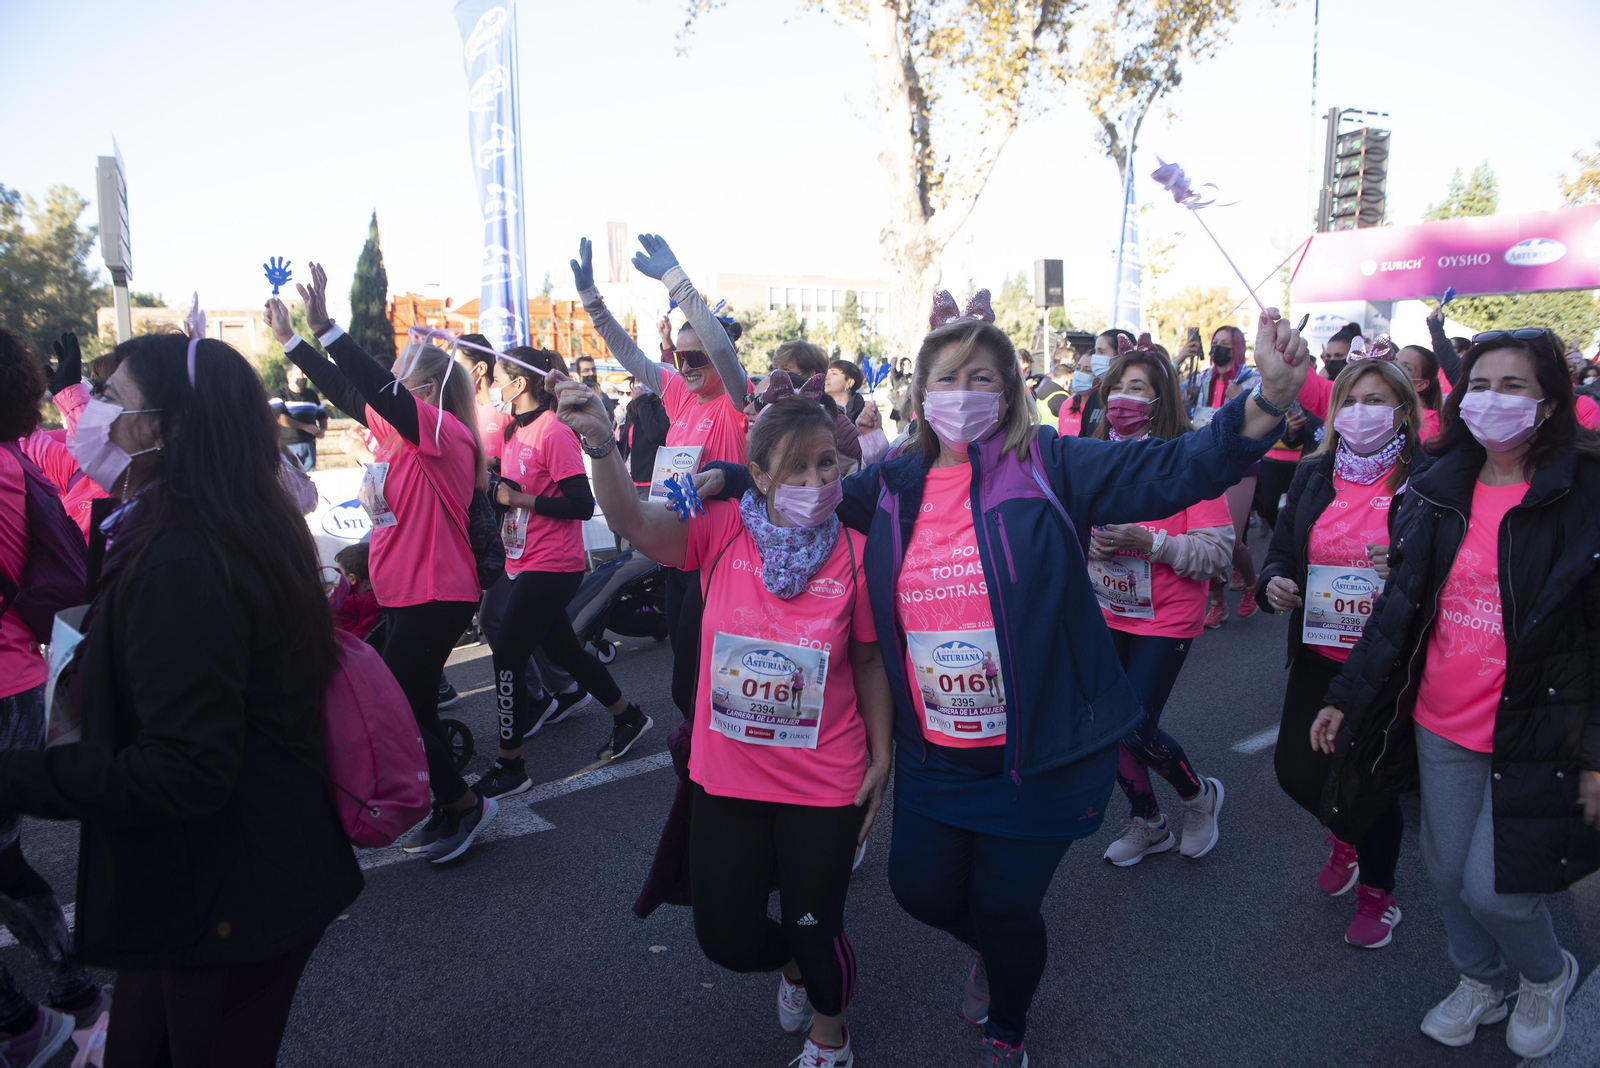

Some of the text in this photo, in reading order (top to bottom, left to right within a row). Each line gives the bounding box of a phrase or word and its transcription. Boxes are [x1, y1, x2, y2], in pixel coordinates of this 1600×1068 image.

[1380, 258, 1423, 272] ZURICH
[1438, 253, 1491, 268] OYSHO
[951, 545, 980, 559] PO
[732, 558, 763, 578] OYSH
[930, 561, 984, 581] TODAS
[808, 585, 844, 595] ASTURIANA
[1102, 575, 1129, 592] 016
[1334, 581, 1371, 591] ASTURIANA
[900, 581, 988, 604] NOSOTRAS
[1334, 598, 1372, 615] 016
[1322, 622, 1346, 630] CARRERA
[1340, 616, 1361, 625] 2396
[1442, 608, 1505, 636] NOSOTR
[1307, 631, 1337, 641] OYSHO
[799, 637, 833, 652] POR
[746, 655, 793, 672] ASTURIANA
[936, 650, 981, 662] ASTURIANA
[741, 678, 790, 703] 016
[938, 674, 986, 693] 016
[498, 669, 514, 740] adidas
[749, 702, 775, 715] 2394
[951, 697, 975, 707] 2395
[726, 708, 800, 726] CARRERA DE LA MUJER
[959, 706, 968, 715] DE
[969, 707, 978, 715] LA
[979, 706, 1005, 715] MUJER
[714, 717, 742, 734] OYSHO
[789, 733, 811, 741] ZURICH
